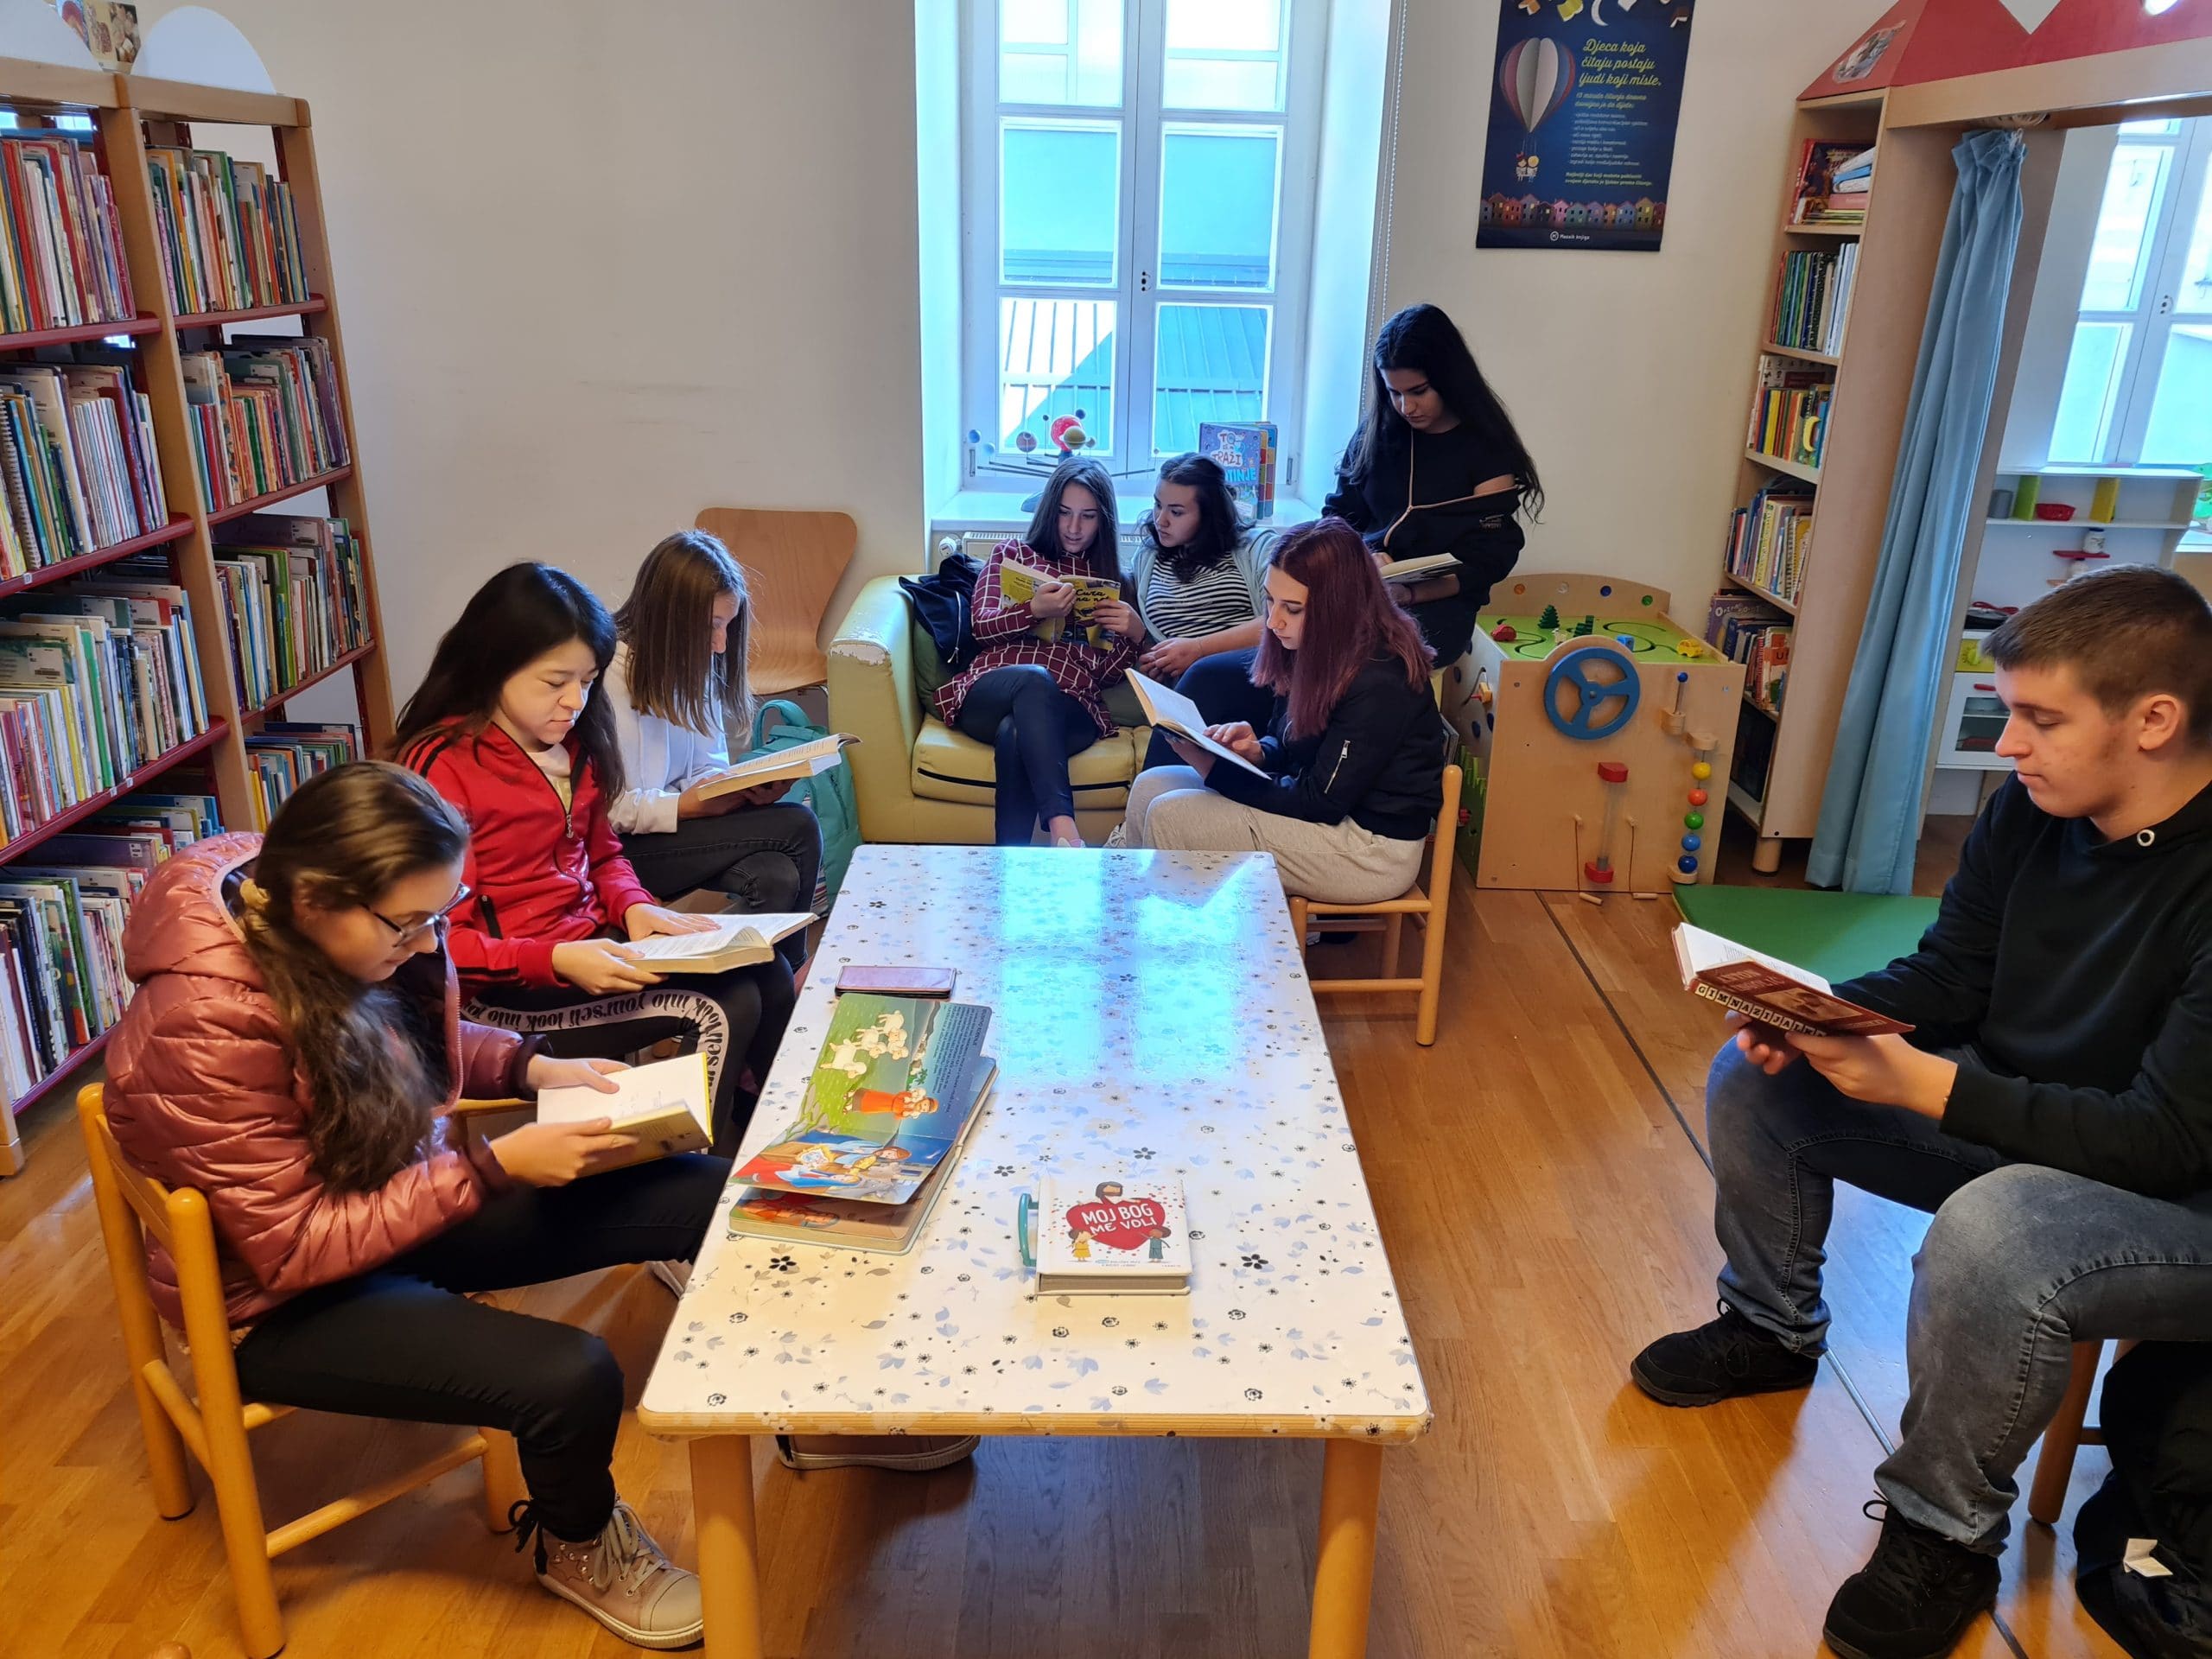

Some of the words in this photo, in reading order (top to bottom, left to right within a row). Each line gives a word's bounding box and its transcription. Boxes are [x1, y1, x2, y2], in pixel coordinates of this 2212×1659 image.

[1583, 38, 1618, 54] Djeca
[1620, 41, 1646, 56] koja
[1581, 57, 1613, 71] čitaju
[1614, 58, 1656, 72] postaju
[1579, 72, 1605, 87] ljudi
[1606, 73, 1628, 88] koji
[1211, 450, 1242, 465] TRAŽI
[567, 992, 646, 1028] yourself
[652, 992, 690, 1016] into
[486, 1008, 524, 1030] into
[526, 1009, 563, 1032] look
[1081, 1206, 1117, 1226] MOJ
[1118, 1202, 1154, 1220] BOG
[1090, 1222, 1117, 1236] ME
[1120, 1217, 1157, 1230] VOLI
